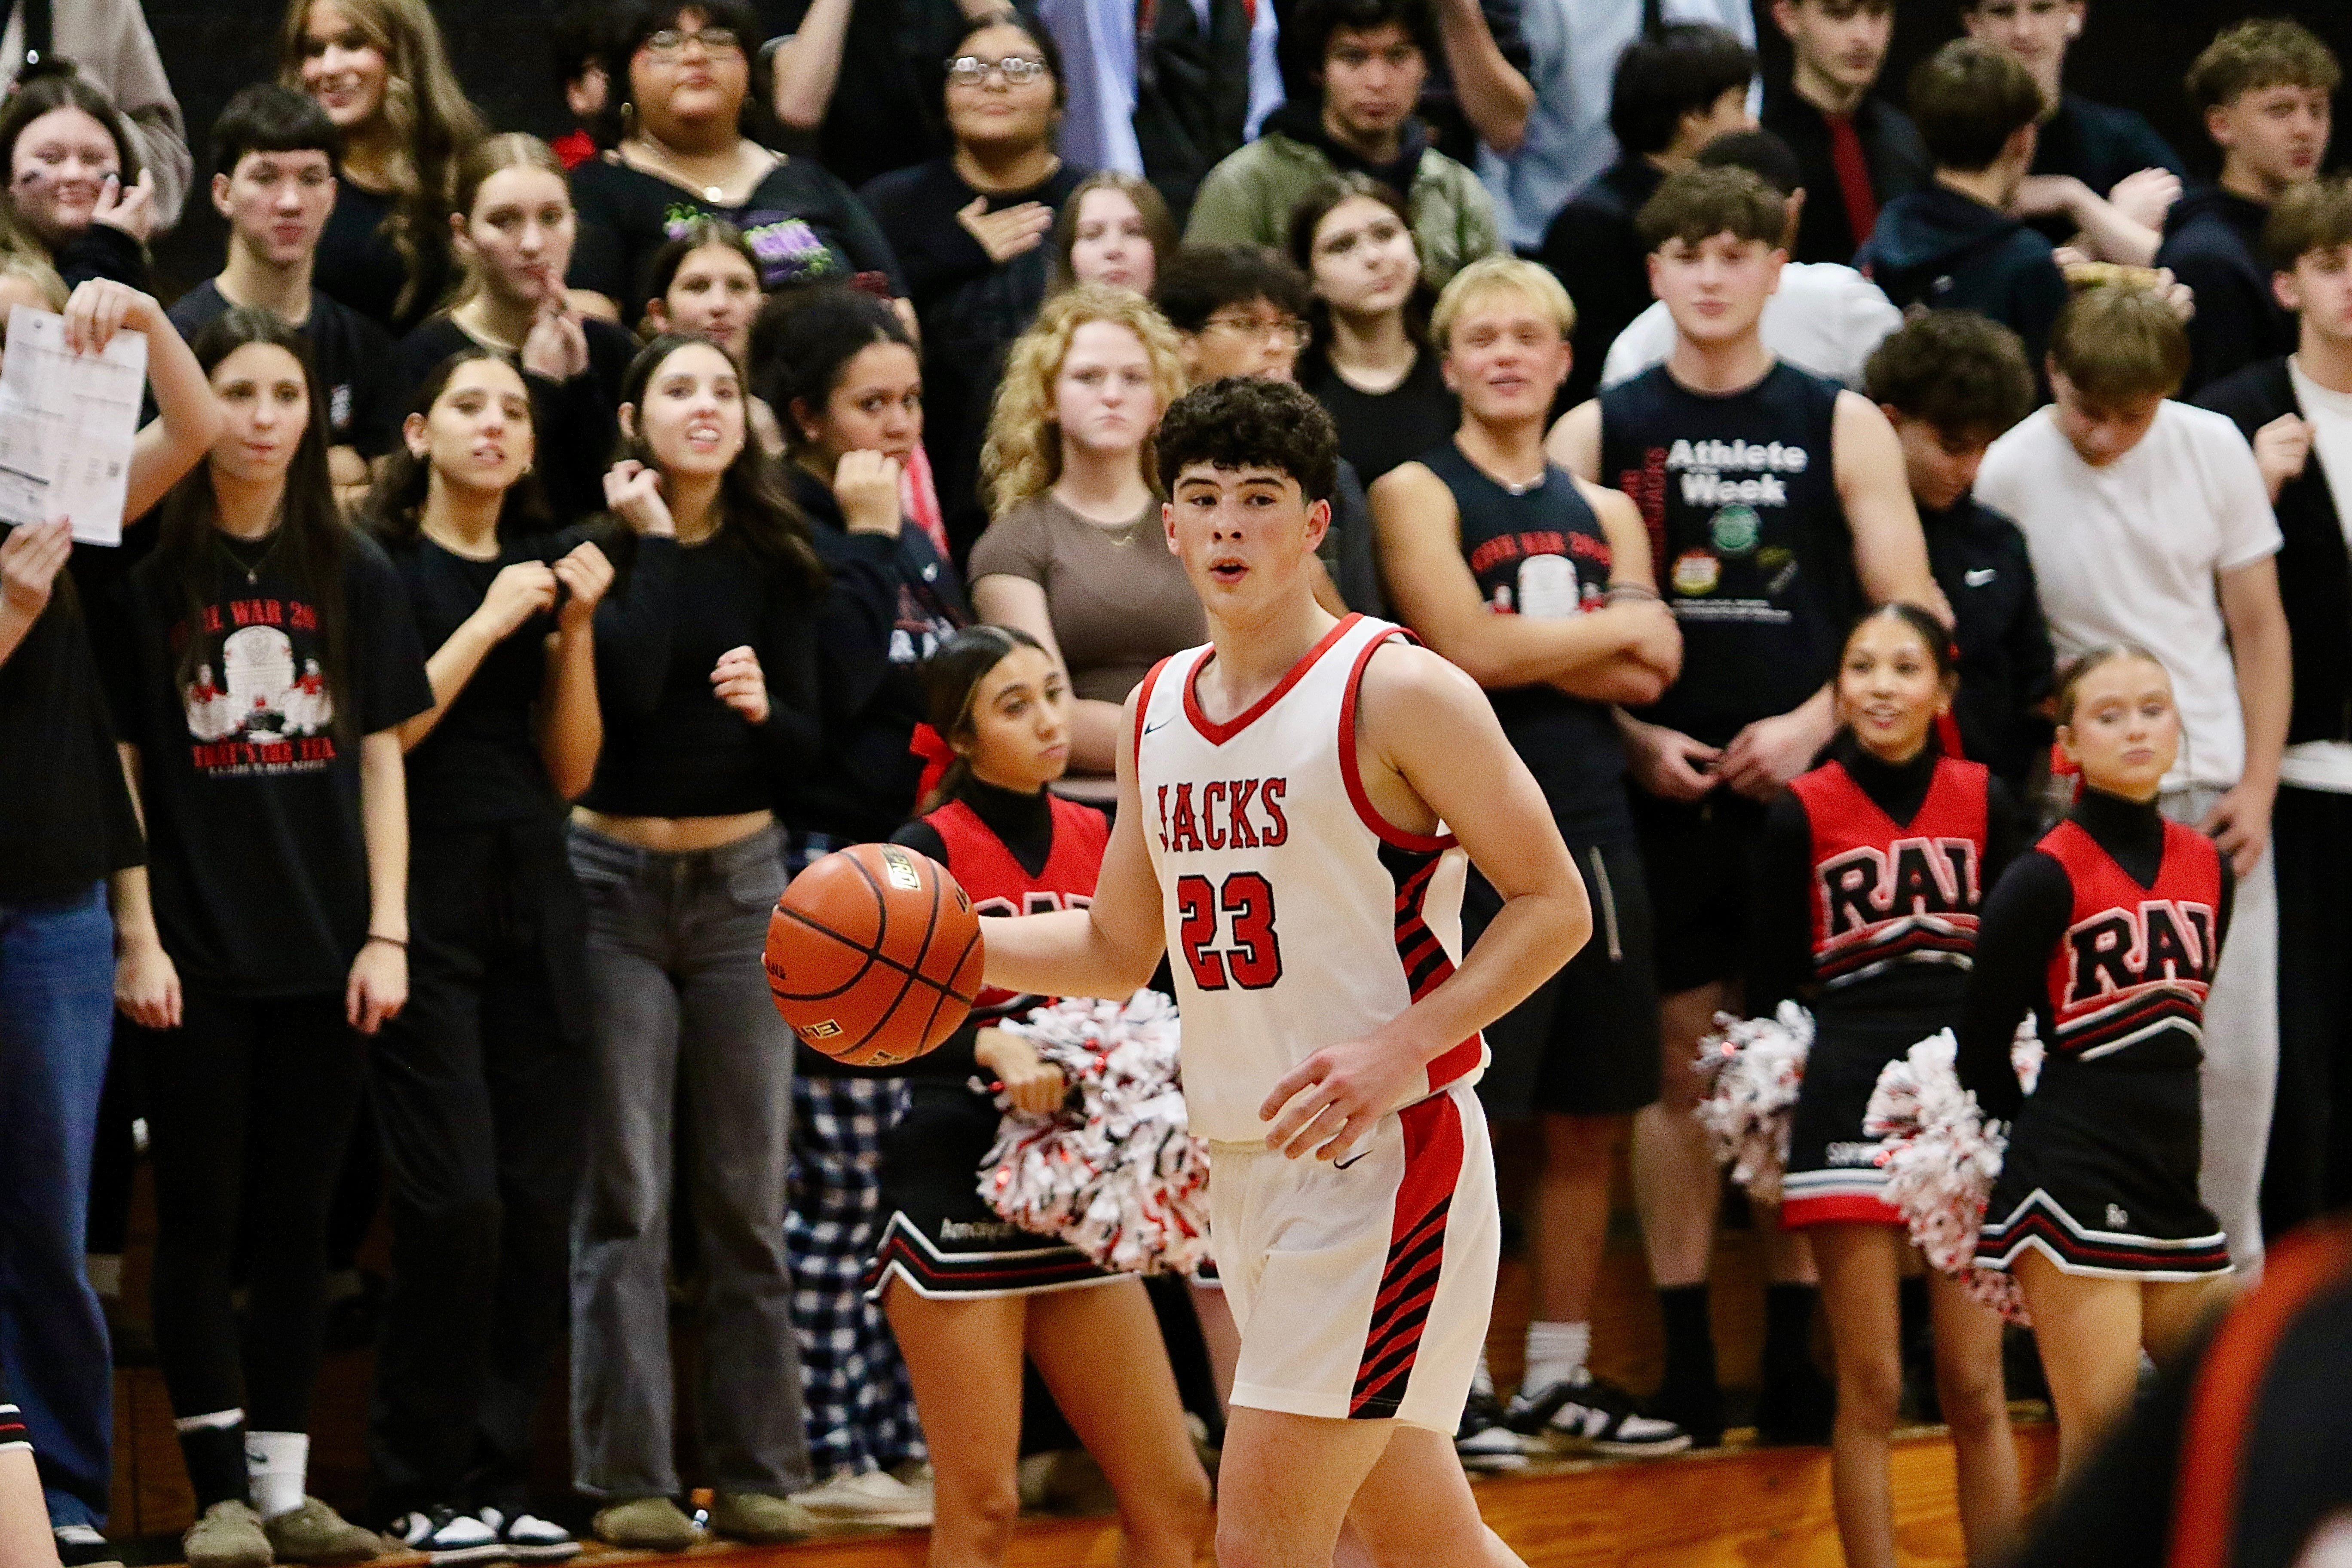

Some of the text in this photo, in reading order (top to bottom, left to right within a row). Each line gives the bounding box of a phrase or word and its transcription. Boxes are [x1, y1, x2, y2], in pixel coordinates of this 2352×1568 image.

[1666, 439, 1808, 472] Athlete
[1681, 472, 1787, 507] Week
[1158, 777, 1288, 853] JACKS
[1177, 871, 1283, 991] 23
